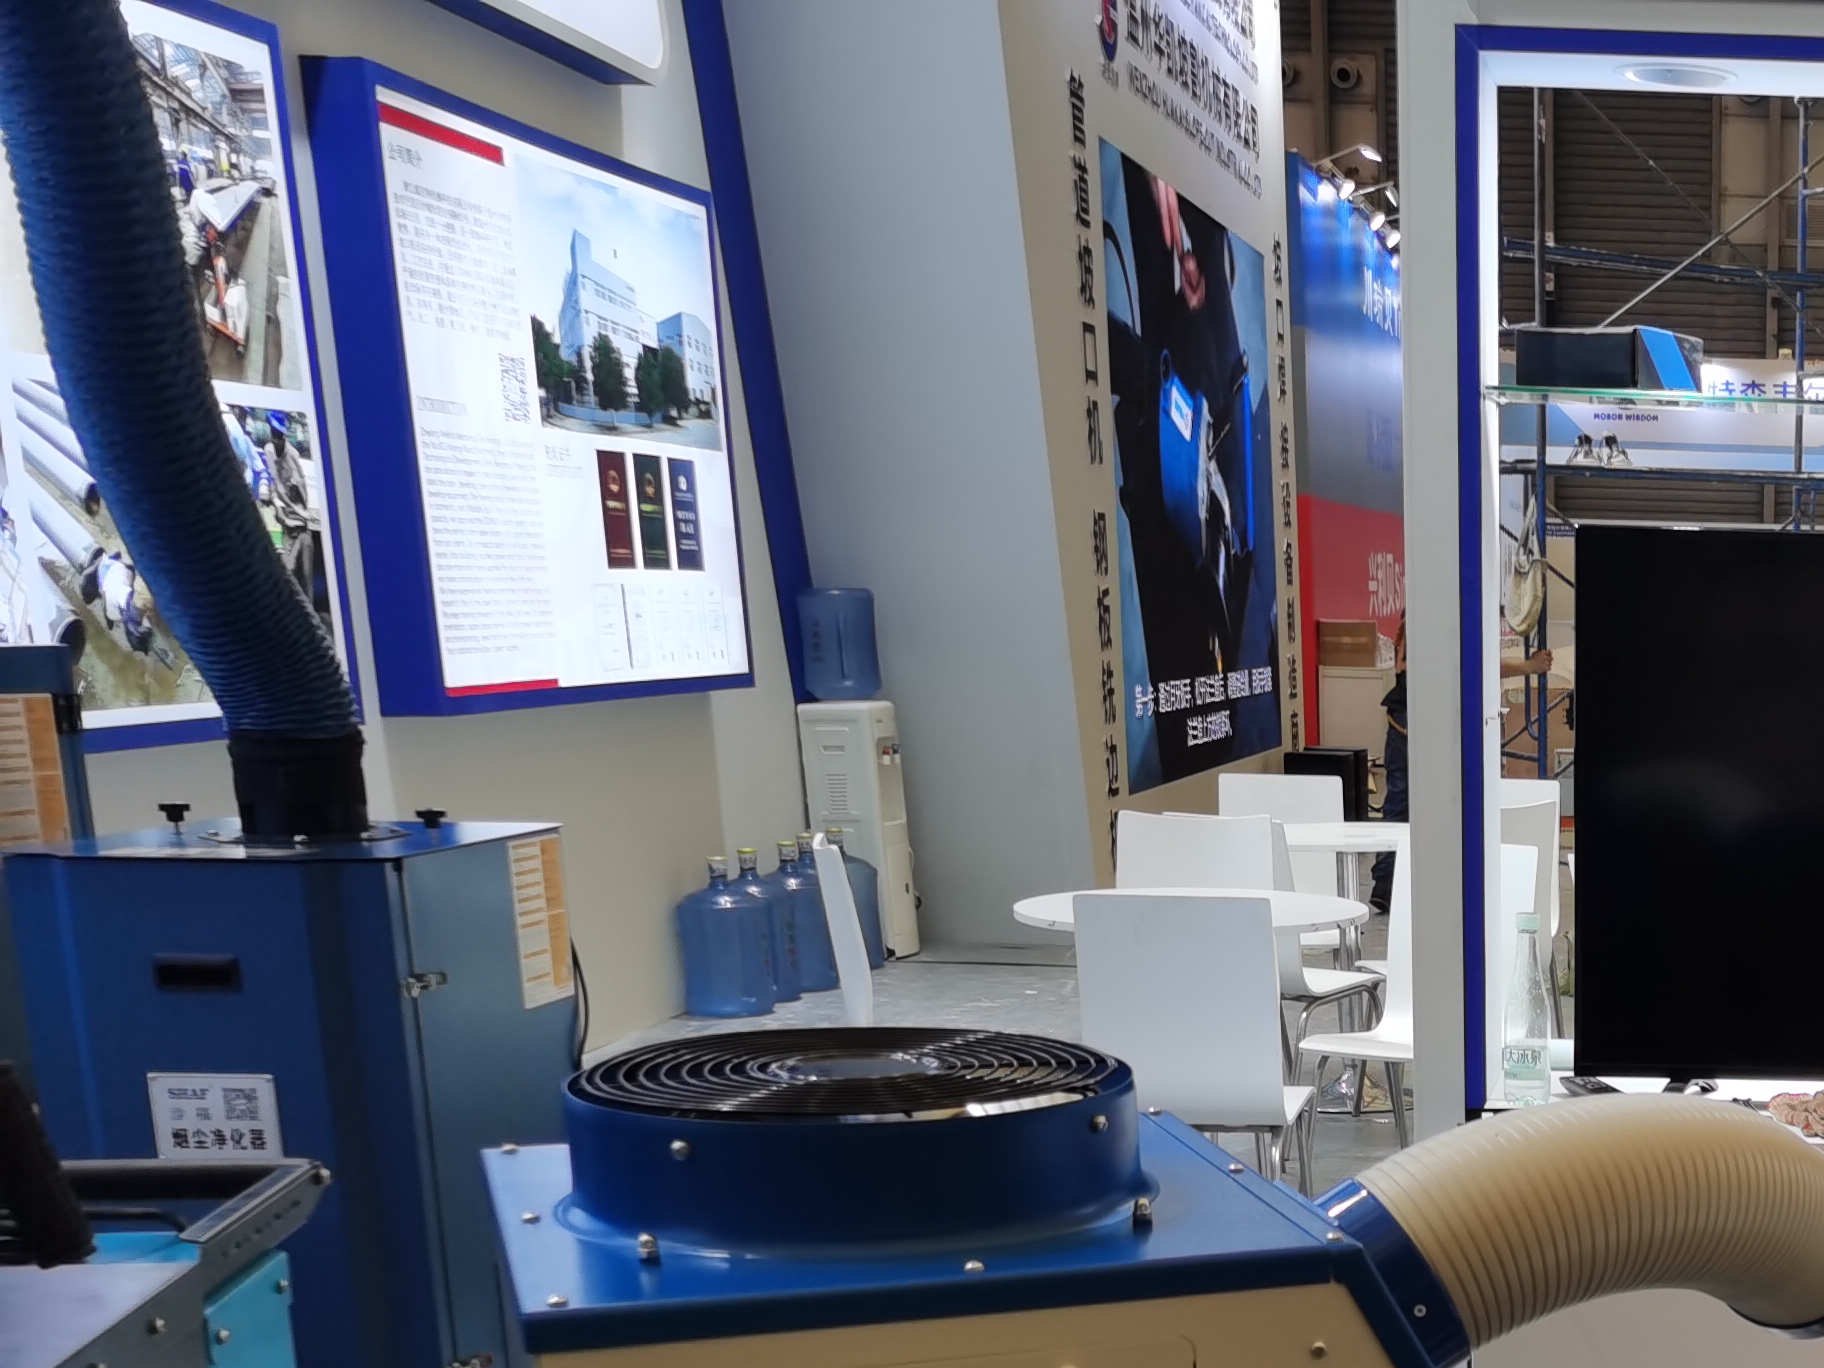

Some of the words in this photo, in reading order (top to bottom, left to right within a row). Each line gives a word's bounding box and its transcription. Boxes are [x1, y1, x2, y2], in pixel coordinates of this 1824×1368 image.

[1068, 67, 1103, 465] 管道坡口机
